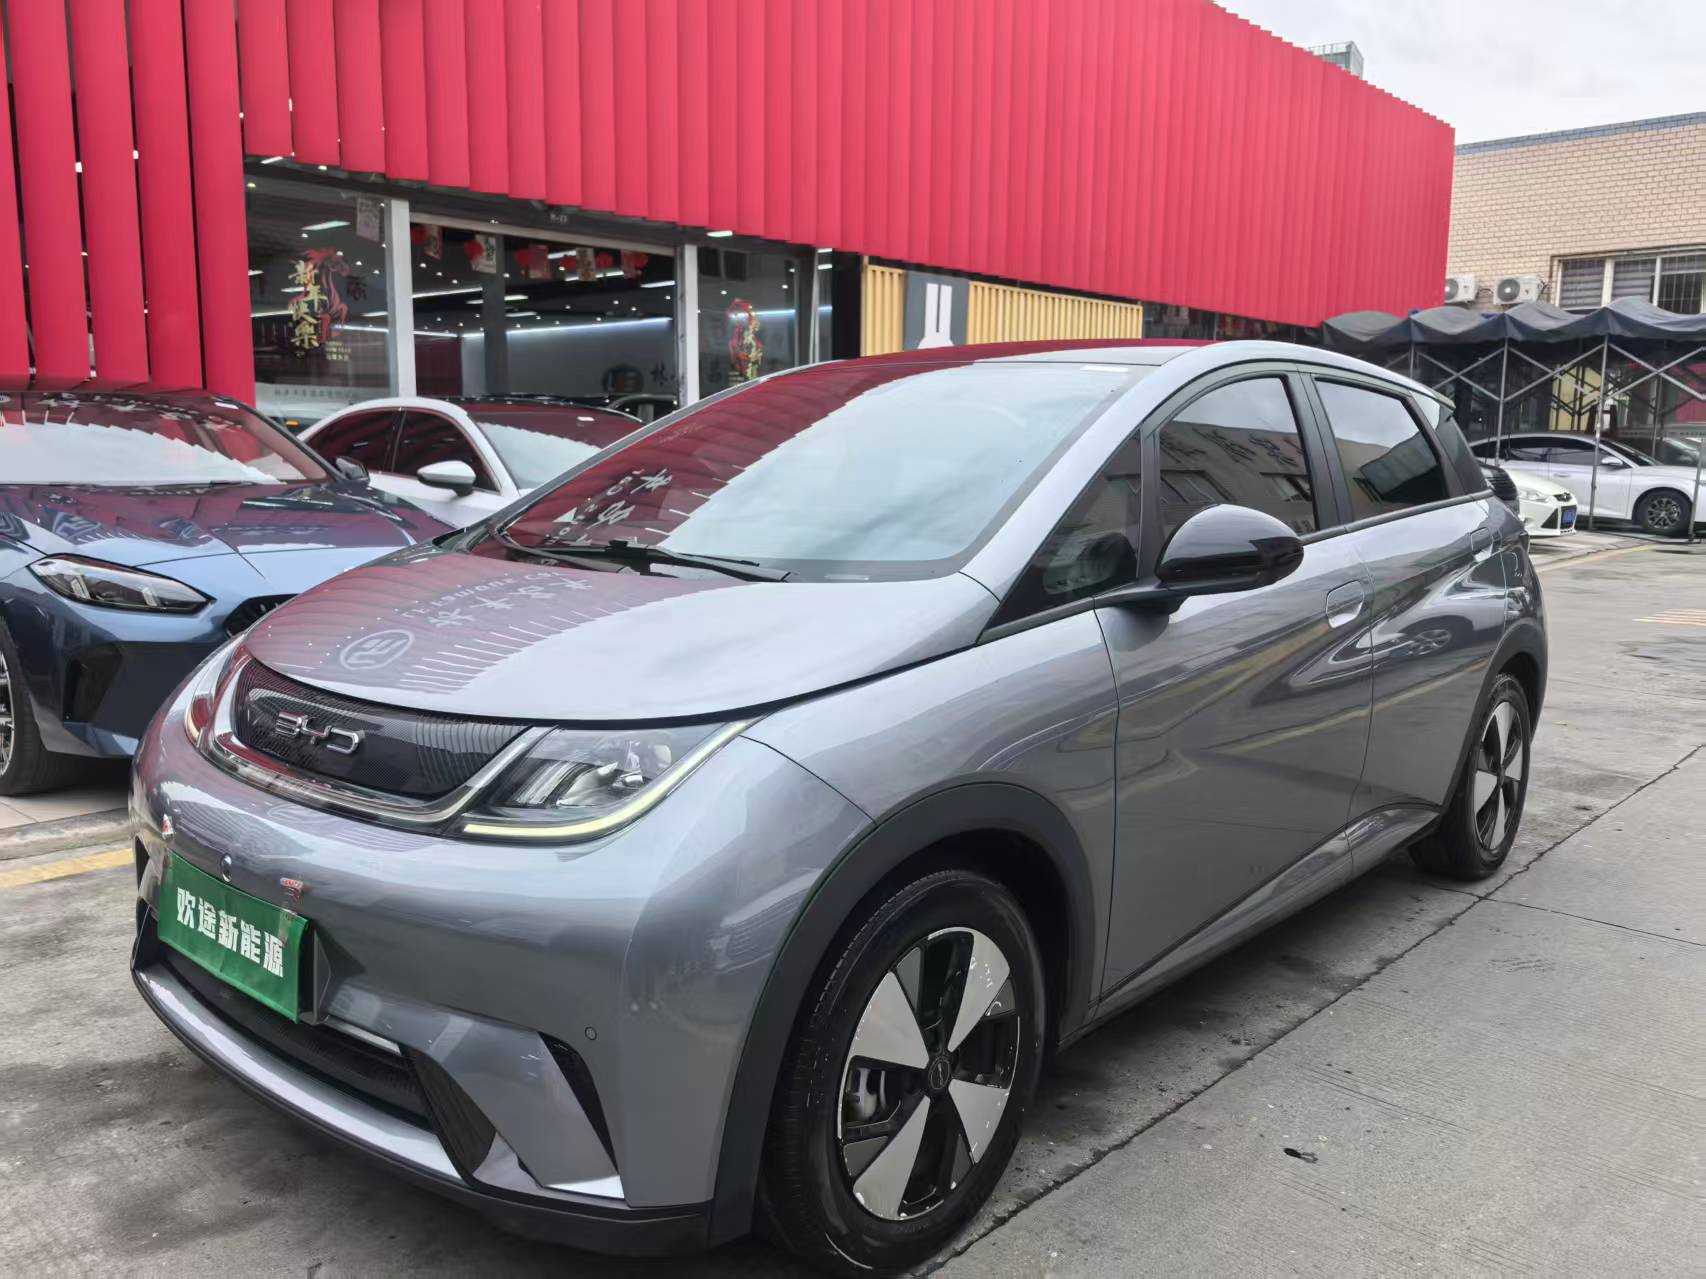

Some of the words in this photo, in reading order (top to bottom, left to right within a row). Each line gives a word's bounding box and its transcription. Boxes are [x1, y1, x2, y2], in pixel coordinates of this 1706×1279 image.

[275, 712, 360, 755] BYD
[176, 887, 285, 978] 欢途新能源
